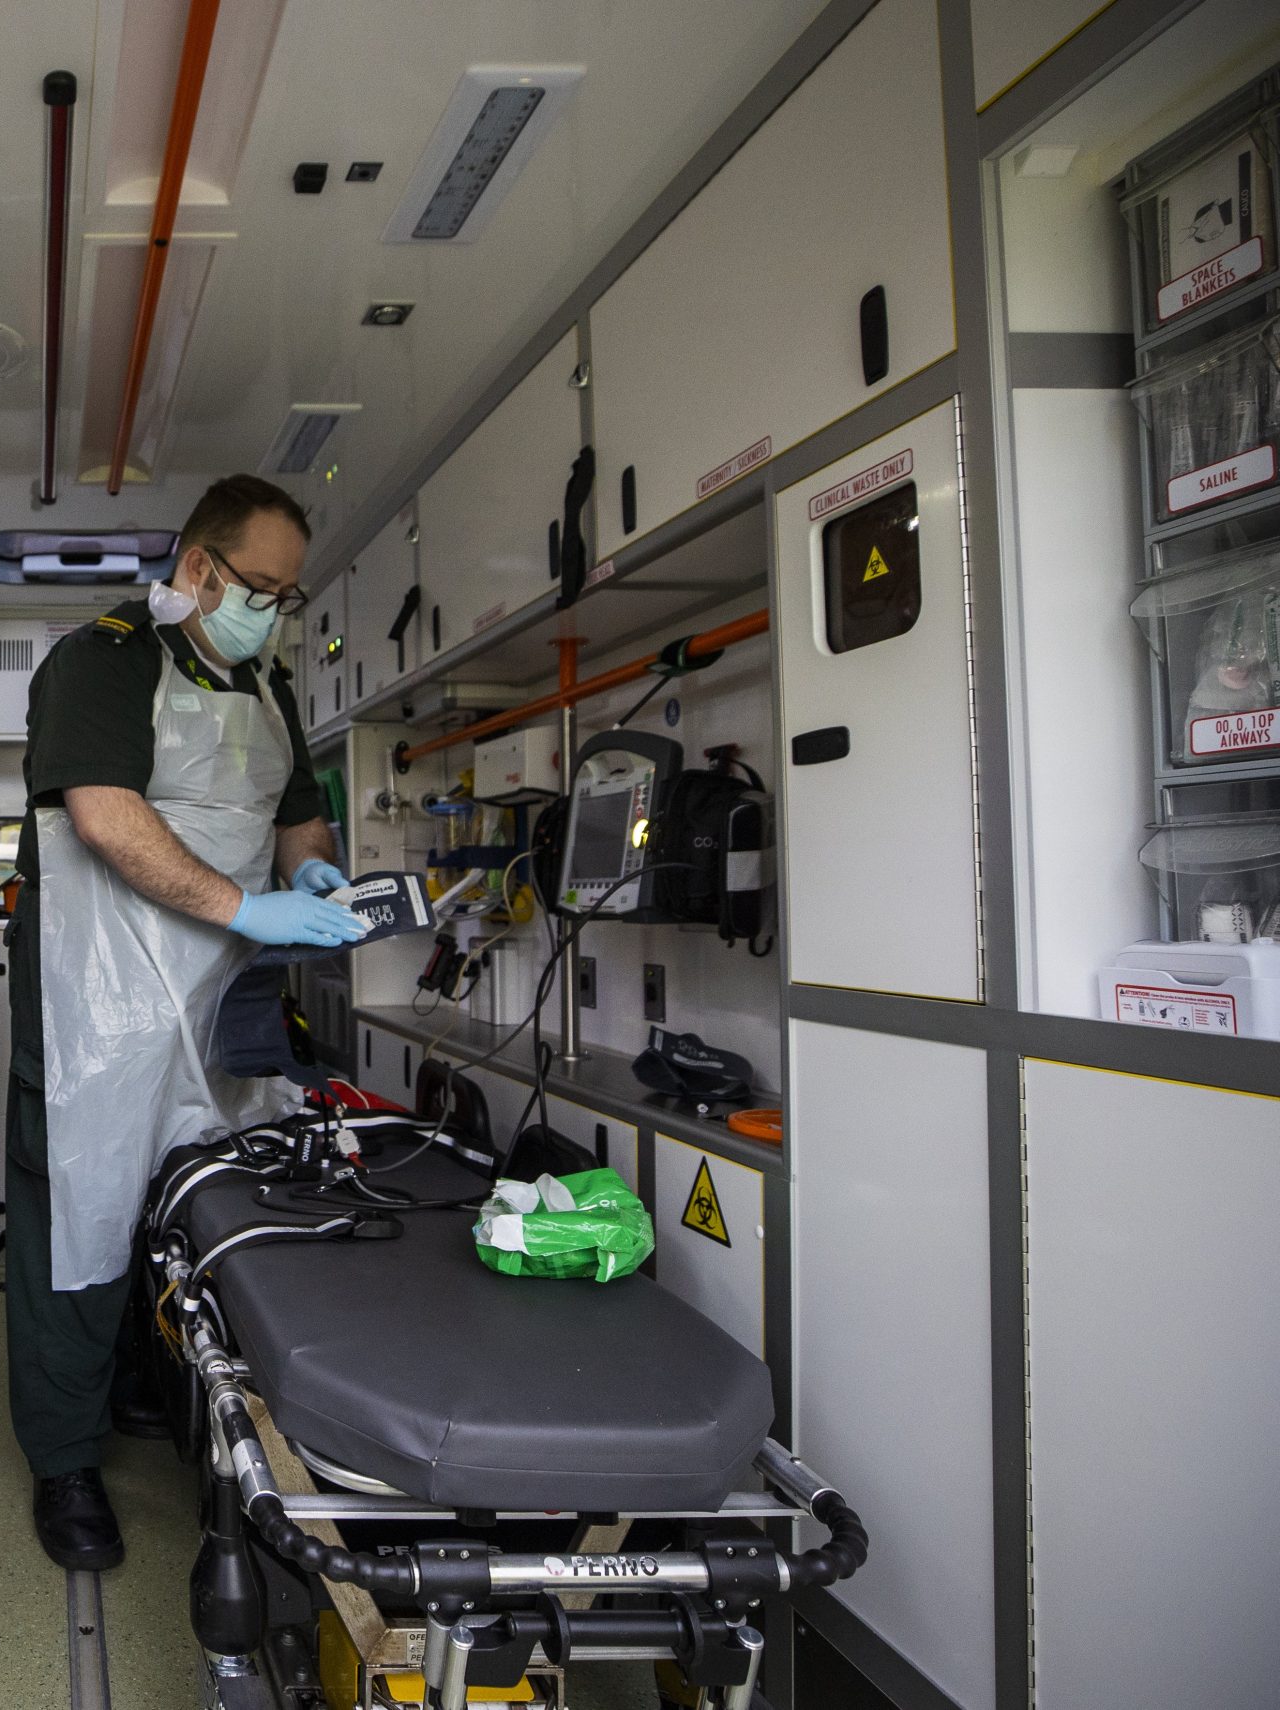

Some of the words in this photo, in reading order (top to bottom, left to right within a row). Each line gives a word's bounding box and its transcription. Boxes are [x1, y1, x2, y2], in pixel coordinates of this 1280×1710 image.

[1190, 259, 1224, 288] SPACE
[1181, 268, 1236, 308] BLANKETS
[701, 464, 732, 492] MATERNITY
[815, 485, 850, 514] CLINICAL
[852, 469, 880, 495] WASTE
[882, 456, 905, 480] ONLY
[1199, 466, 1238, 493] SALINE
[1220, 729, 1271, 748] AIRWAYS
[301, 1133, 313, 1162] FERNO
[572, 1555, 660, 1577] FERNO
